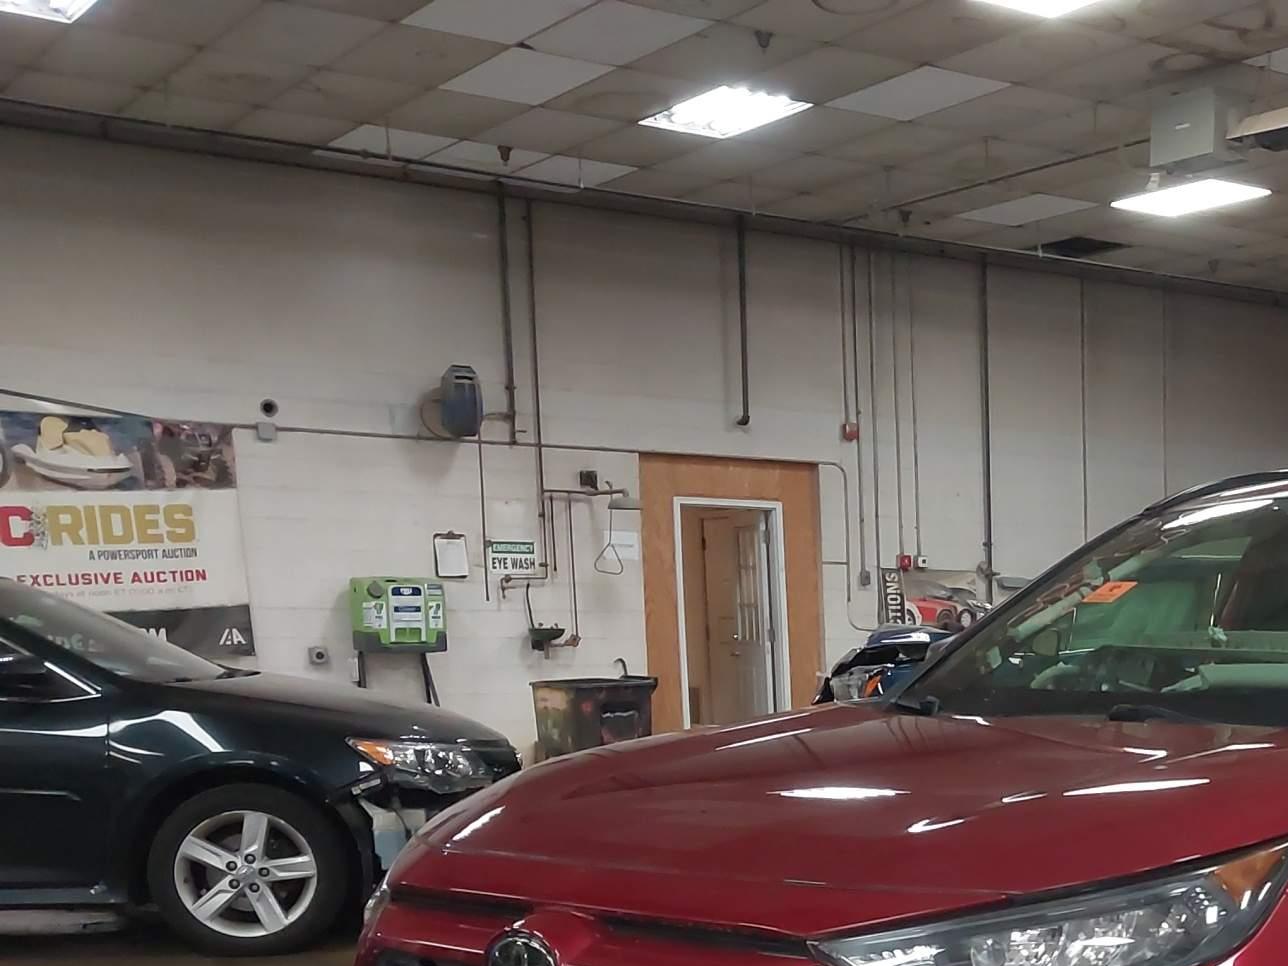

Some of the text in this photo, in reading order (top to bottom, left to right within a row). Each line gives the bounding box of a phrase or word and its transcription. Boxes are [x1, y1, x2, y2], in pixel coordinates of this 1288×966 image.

[47, 503, 196, 546] RIDES
[88, 547, 198, 561] A POWERSPORT AUCTION
[491, 557, 536, 570] EYE WASH
[16, 568, 208, 587] EXCLUSIVE AUCTION
